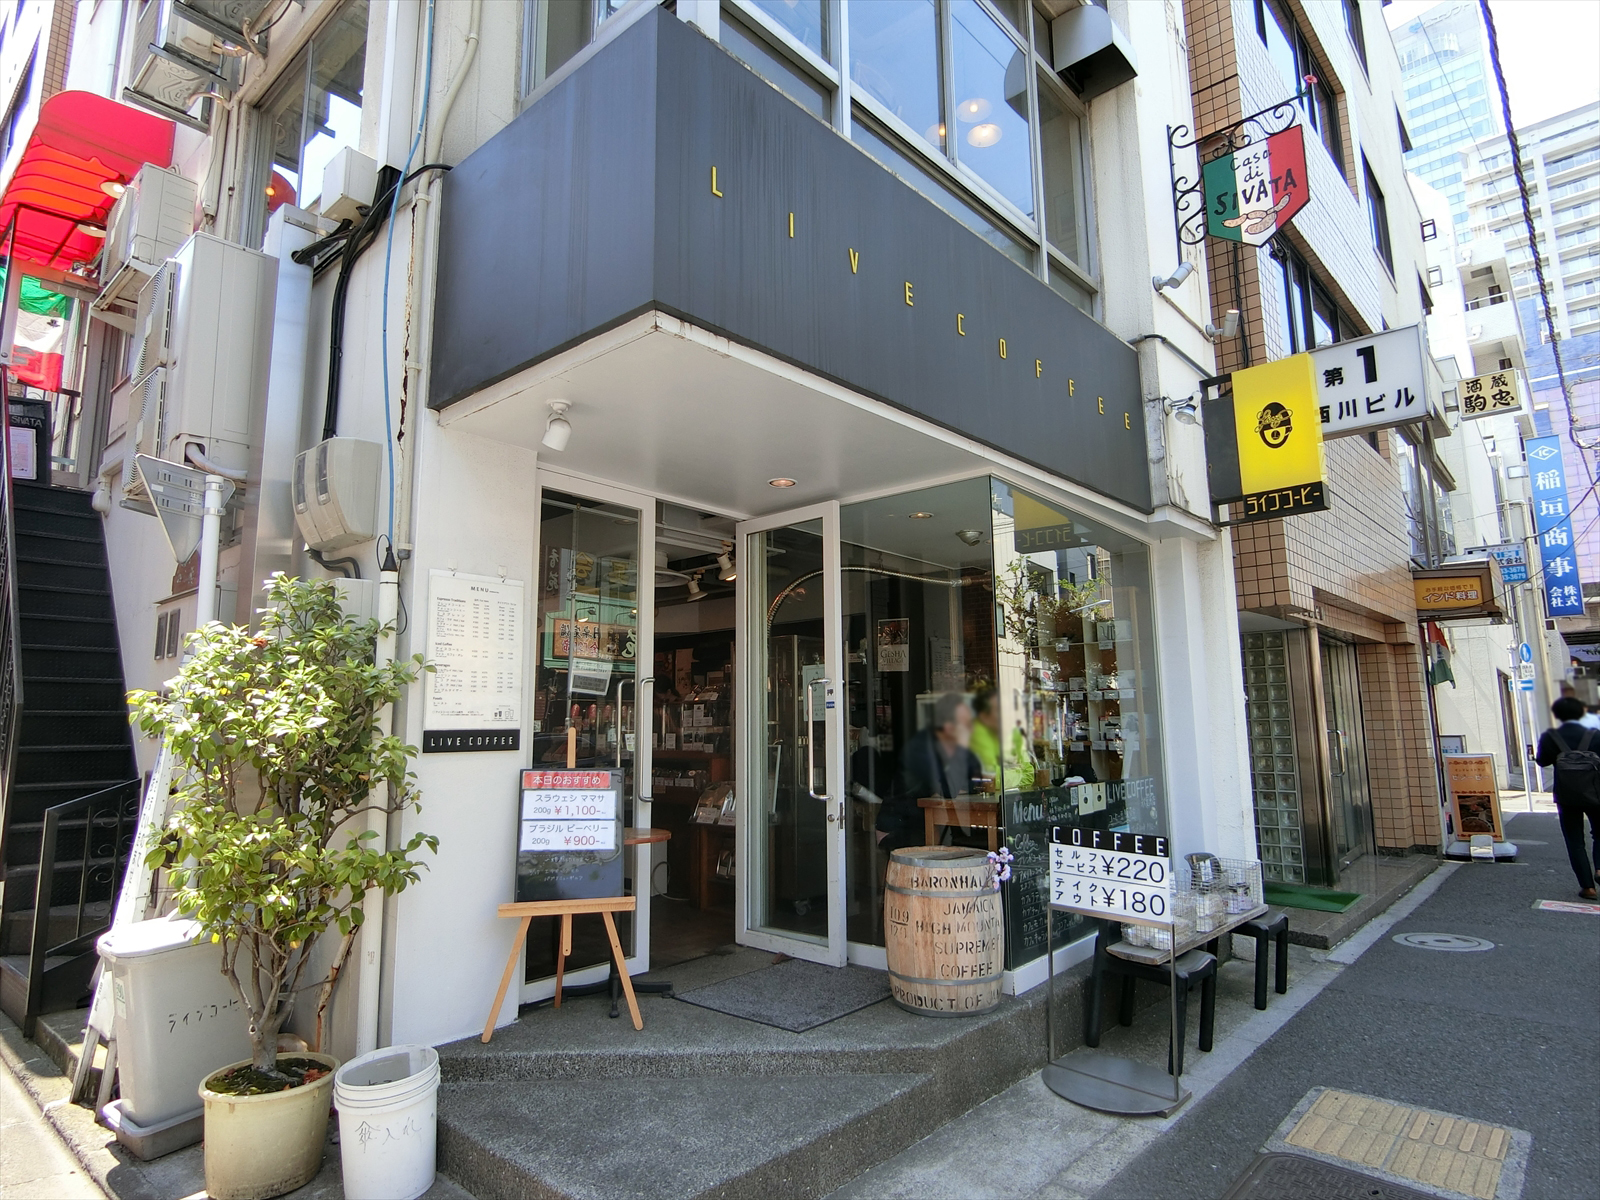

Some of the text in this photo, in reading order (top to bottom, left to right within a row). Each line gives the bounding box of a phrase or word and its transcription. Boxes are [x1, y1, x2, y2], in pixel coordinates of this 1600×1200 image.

[1230, 150, 1272, 171] Casa
[1244, 166, 1264, 183] di
[1213, 168, 1298, 215] SIVATA
[1465, 373, 1508, 394] 酒蔵
[1464, 388, 1515, 413] 駒忠
[1534, 469, 1574, 578] 稲垣商事
[1423, 589, 1478, 603] インド料理
[880, 649, 907, 659] GESHA
[532, 775, 601, 785] 本日のおすすめ
[534, 793, 605, 803] スラウェシ ママサ
[533, 806, 551, 815] 200g
[1012, 801, 1045, 824] Menu
[529, 824, 564, 833] ブラジル
[532, 838, 550, 846] 200g
[1052, 826, 1165, 857] COFFEE
[1054, 848, 1097, 862] セルフ
[1055, 859, 1098, 875] サービス
[1101, 855, 1164, 884] ¥220
[1055, 877, 1098, 894] テイク
[1055, 889, 1098, 907] アウト
[1102, 887, 1165, 917] ¥180
[940, 961, 993, 978] COFFEE
[964, 993, 983, 1009] OF
